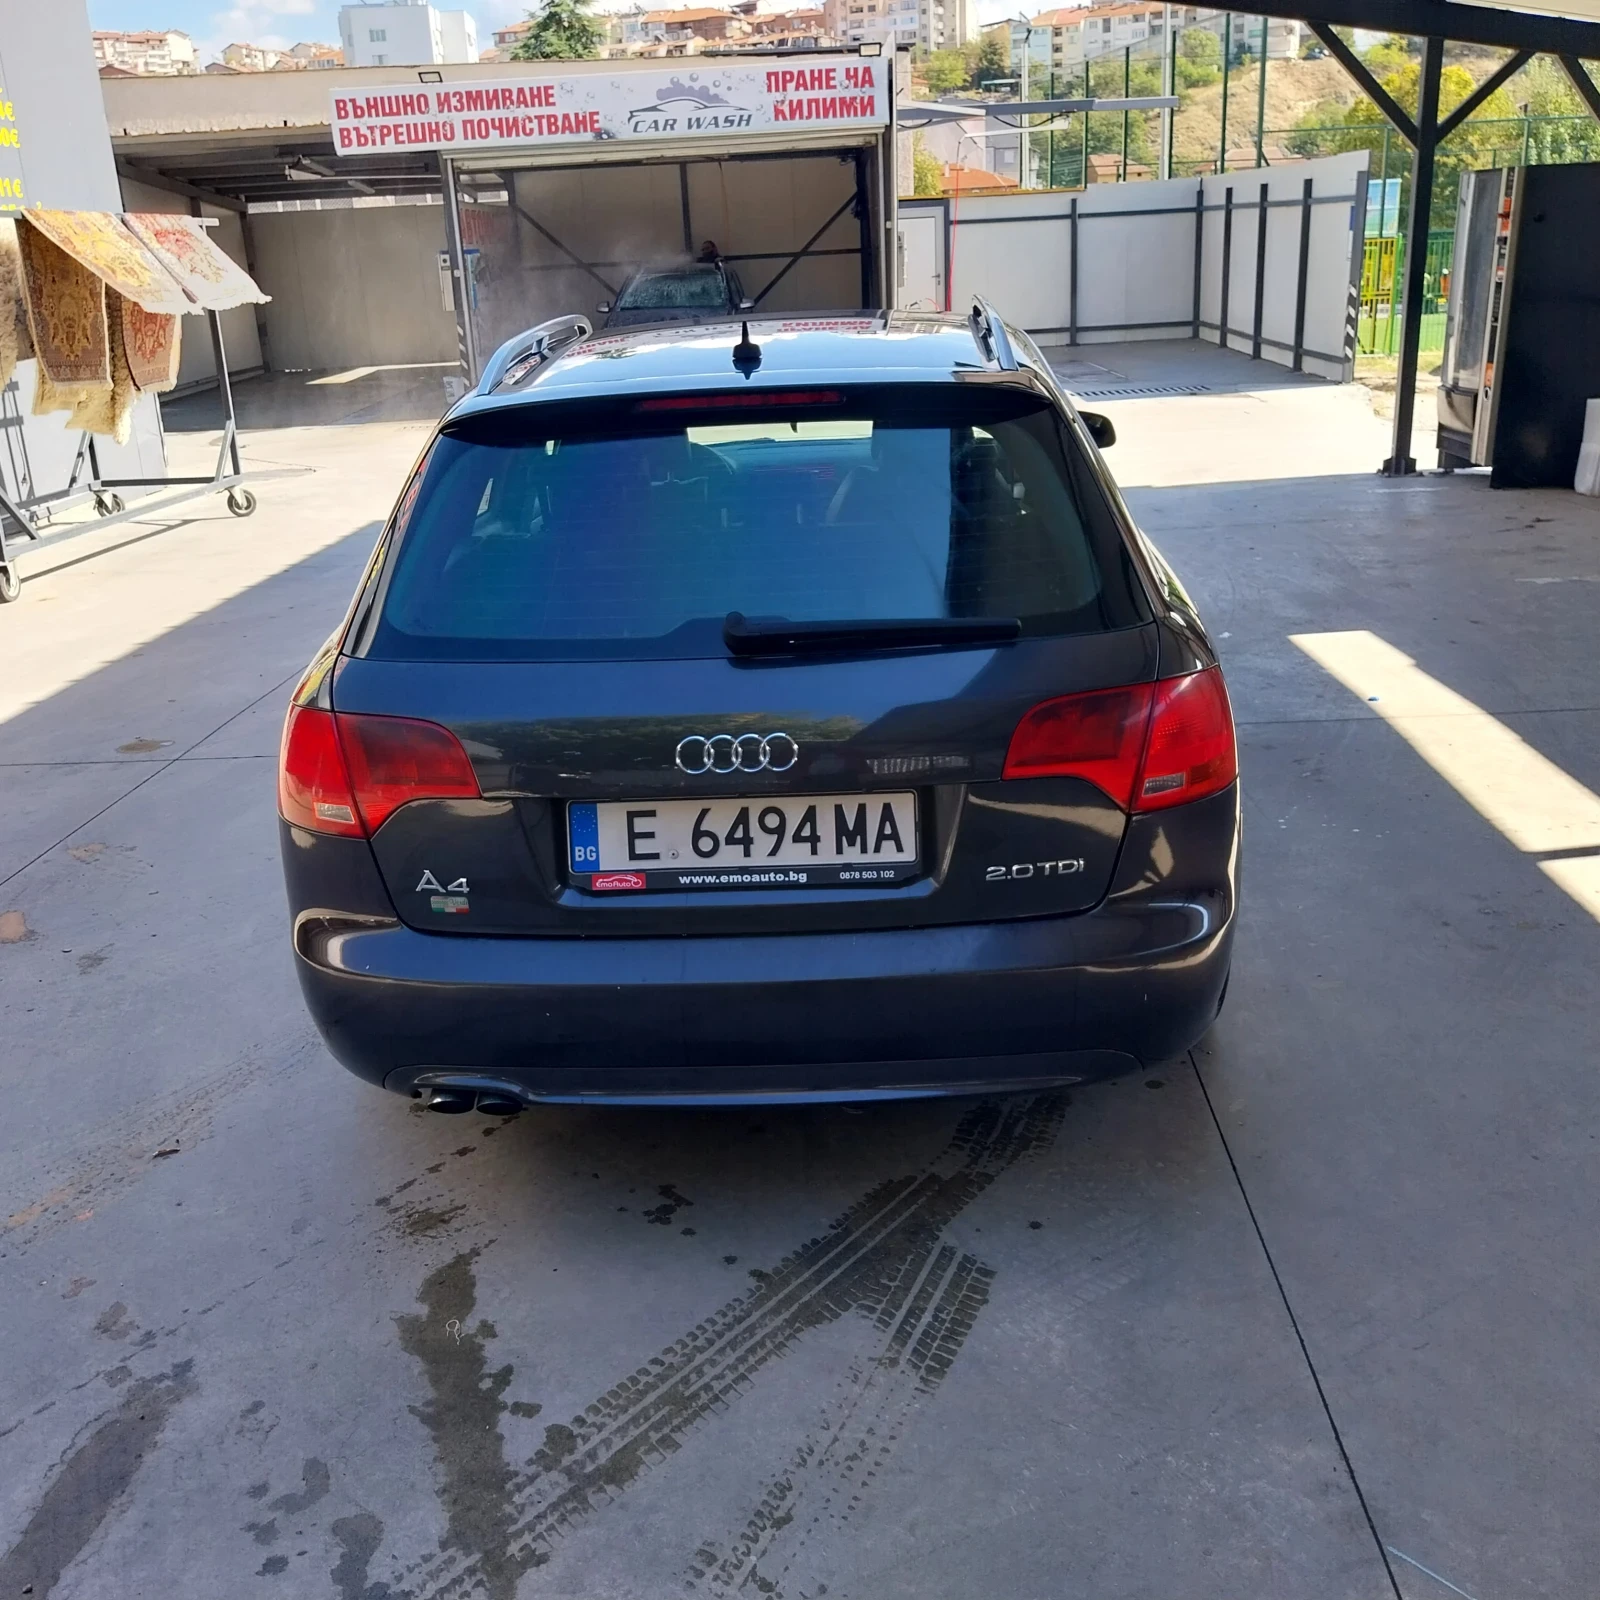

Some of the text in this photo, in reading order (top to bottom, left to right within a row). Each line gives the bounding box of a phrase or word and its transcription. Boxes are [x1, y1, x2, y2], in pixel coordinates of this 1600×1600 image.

[766, 66, 875, 93] ПРАНЕ НА
[335, 85, 556, 120] ВЪНШНО ИЗМИВАНЕ
[774, 95, 875, 121] КИЛИМИ
[339, 111, 601, 148] ВЪТРЕШНО ПОЧИСТВАНЕ
[632, 113, 753, 133] CAR WASH
[626, 802, 904, 861] E 6494 MA
[575, 846, 597, 862] BG
[415, 869, 470, 893] A4
[678, 871, 807, 884] www.emoauto.bg
[840, 870, 895, 879] 0878 503 102
[986, 858, 1085, 881] 2.0 TDI
